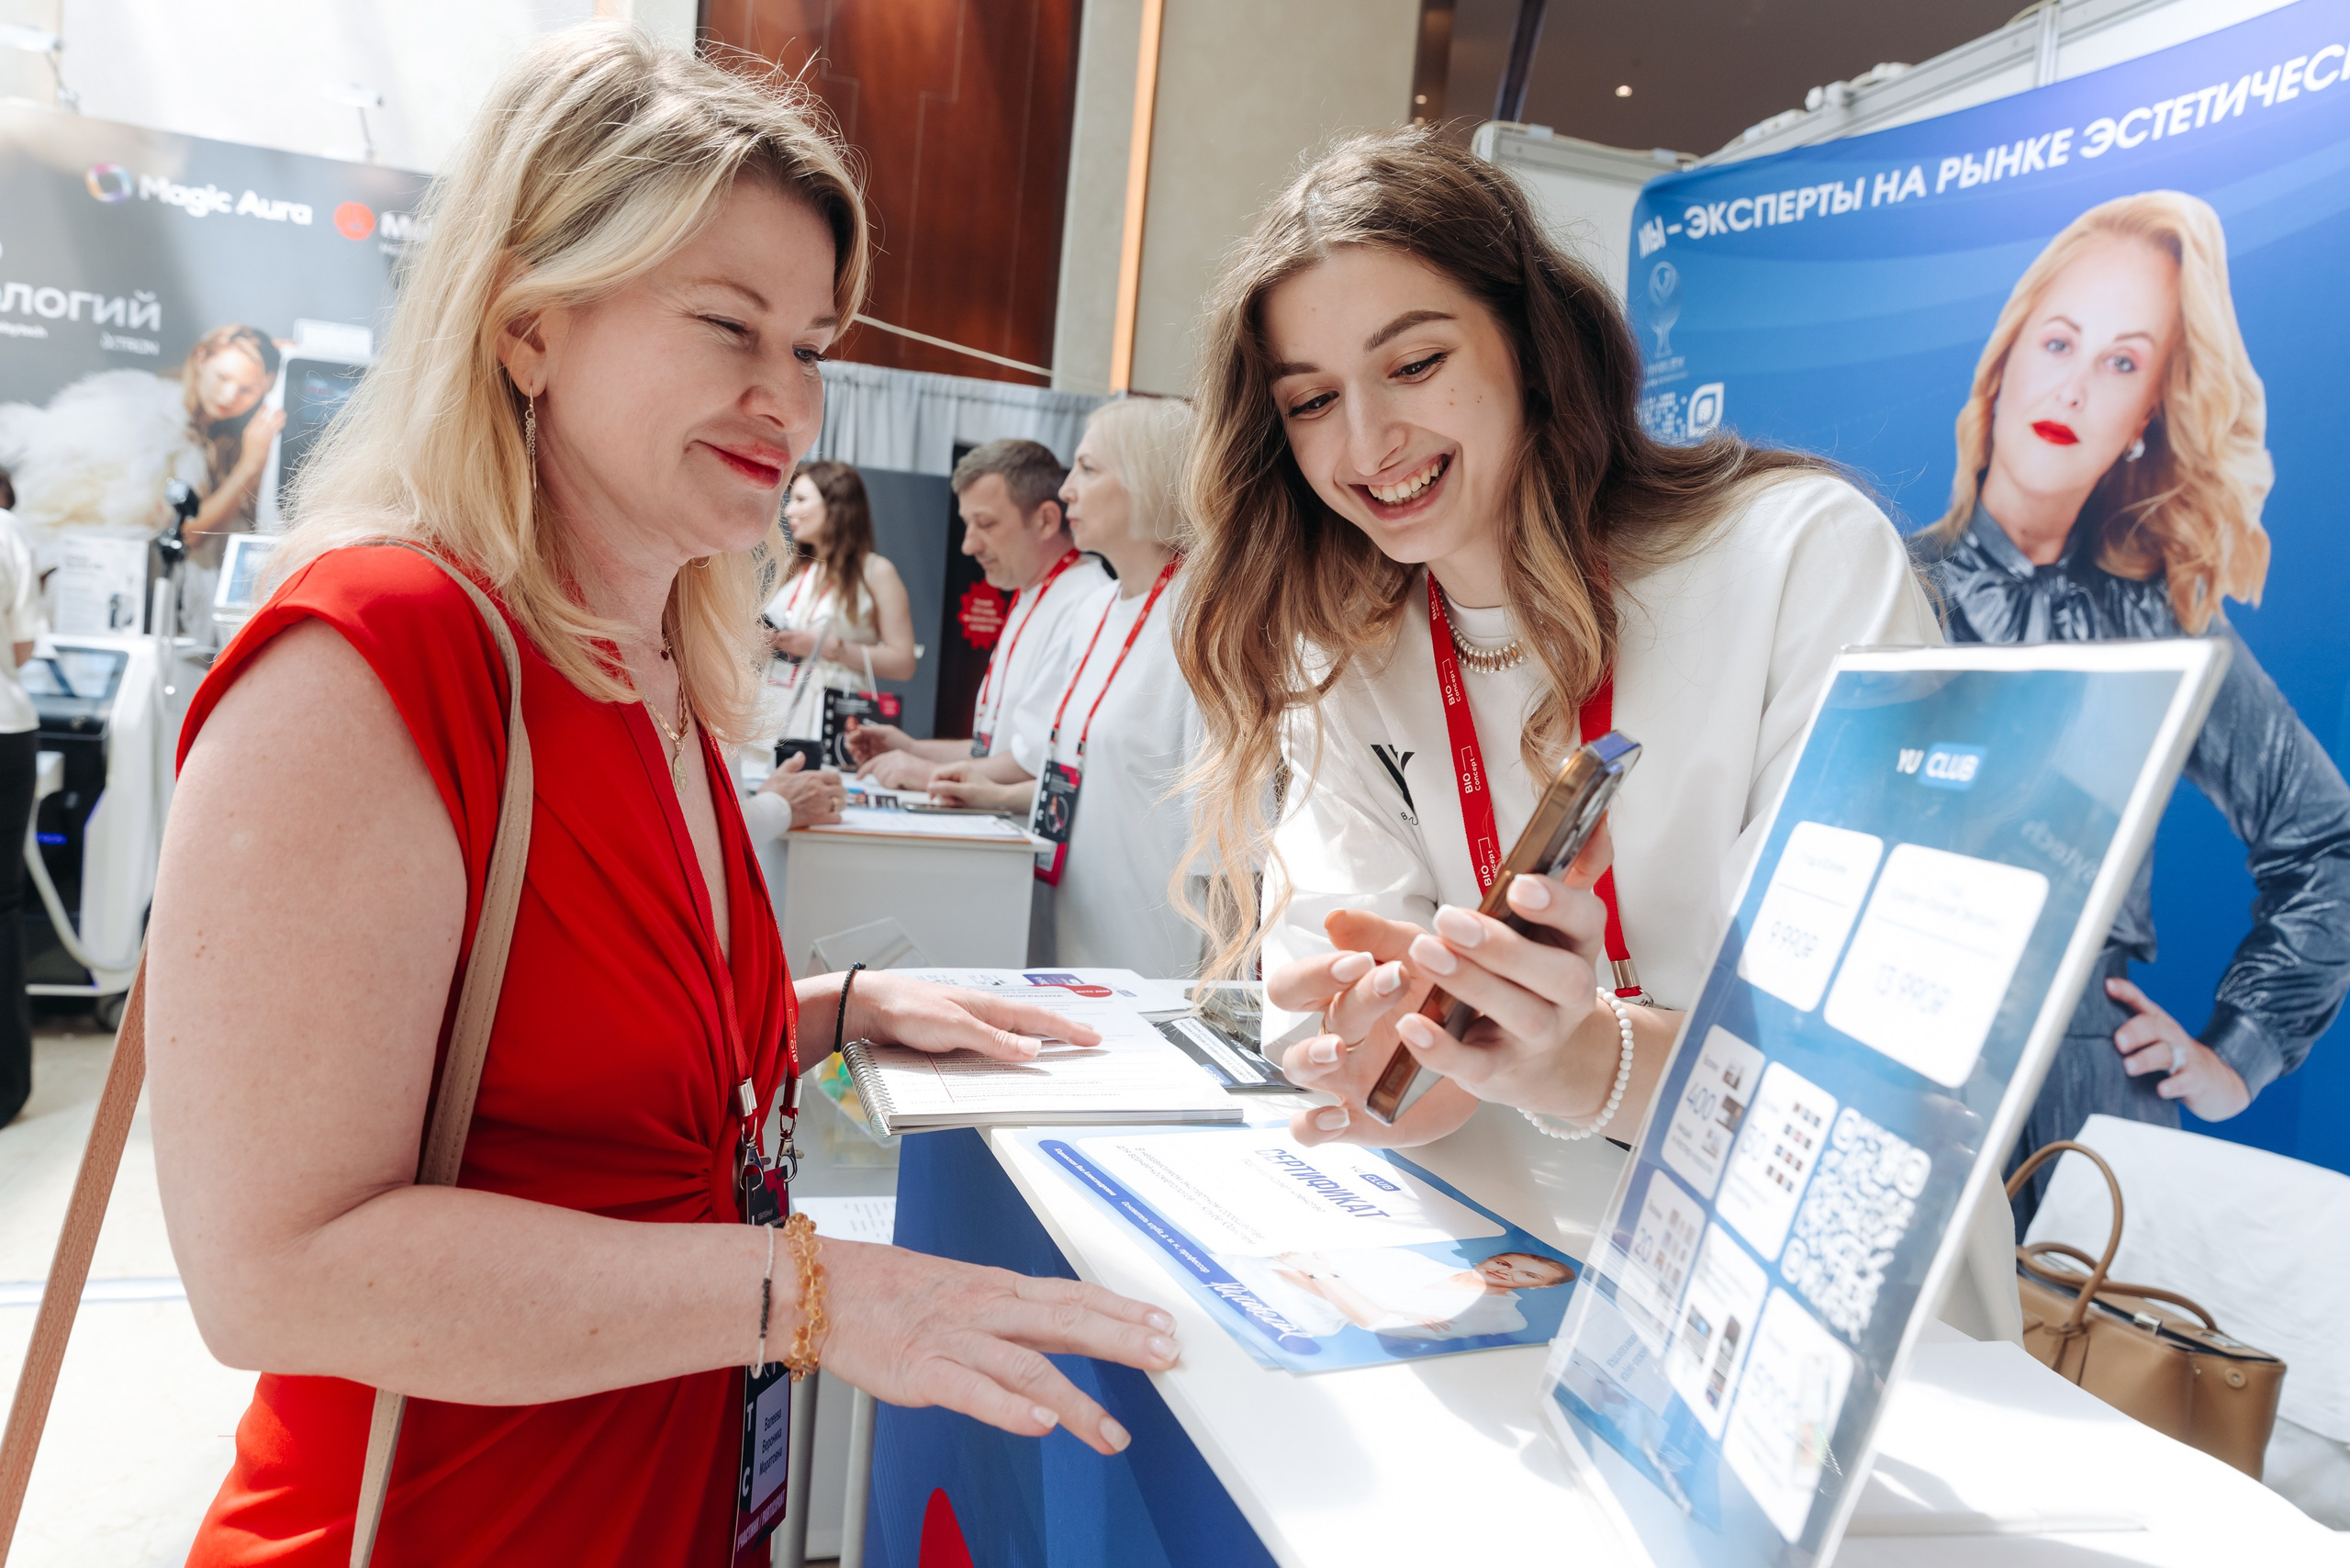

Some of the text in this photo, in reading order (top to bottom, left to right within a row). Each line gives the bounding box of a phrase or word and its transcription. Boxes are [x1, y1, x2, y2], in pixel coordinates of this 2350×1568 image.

[139, 174, 312, 226] Magic Aura
[1684, 177, 1865, 240] ЭКСПЕРТЫ
[1871, 165, 1926, 207] НА
[1935, 127, 2075, 194] РЫНКЕ
[1445, 685, 1455, 706] BIO
[1449, 670, 1461, 702] Concept
[1470, 757, 1482, 791] Concept
[1897, 747, 1979, 782] YU CLUB
[1462, 773, 1473, 794] BIO
[1481, 865, 1493, 887] BIO
[1487, 849, 1498, 879] oncept
[1687, 1081, 1717, 1122] 400
[1254, 1148, 1392, 1217] СЕРТИФИКАТ
[1349, 1165, 1394, 1191] YU CLUB
